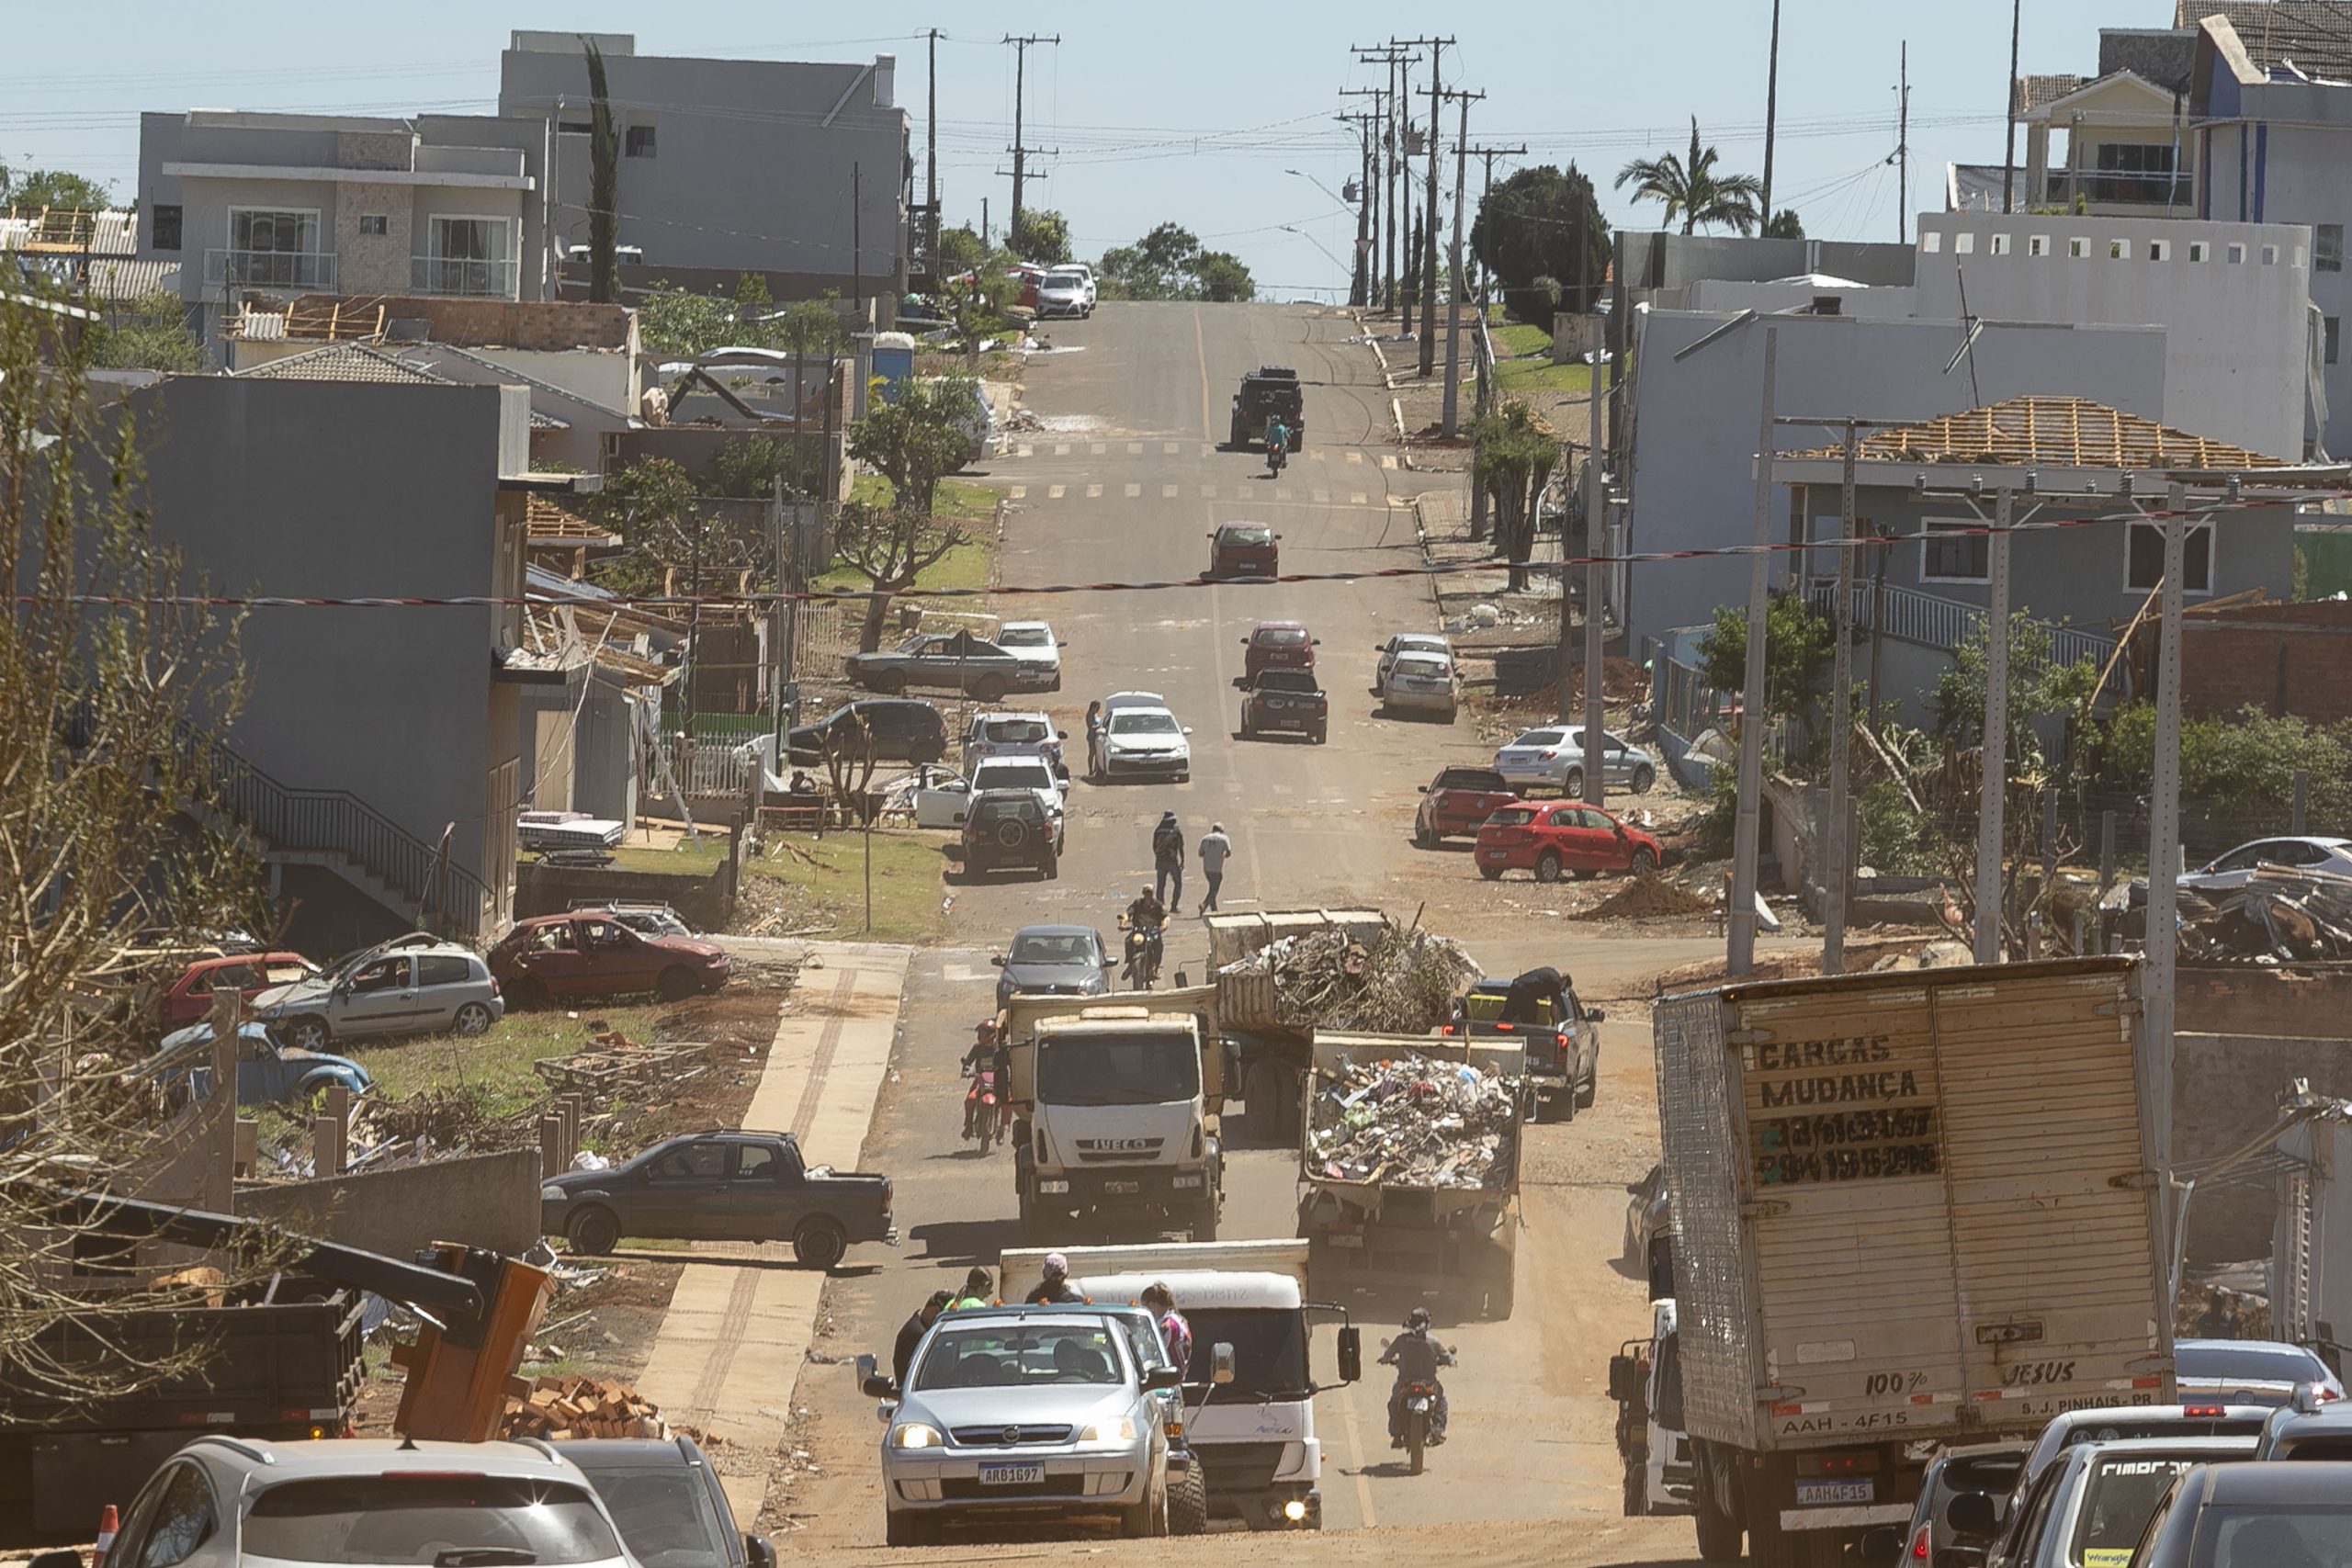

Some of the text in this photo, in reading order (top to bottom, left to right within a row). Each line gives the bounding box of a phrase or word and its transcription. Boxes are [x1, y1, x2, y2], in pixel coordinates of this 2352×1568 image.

[1759, 1034, 1890, 1069] CARGAS
[1761, 1070, 1918, 1108] MUDANÇA
[1093, 1138, 1147, 1150] IVECO
[2002, 1361, 2075, 1385] JESUS
[1782, 1417, 1832, 1434] AAH
[1855, 1412, 1908, 1427] 4F15
[986, 1468, 1038, 1483] ARB1G97
[1805, 1484, 1867, 1502] AAH4F15
